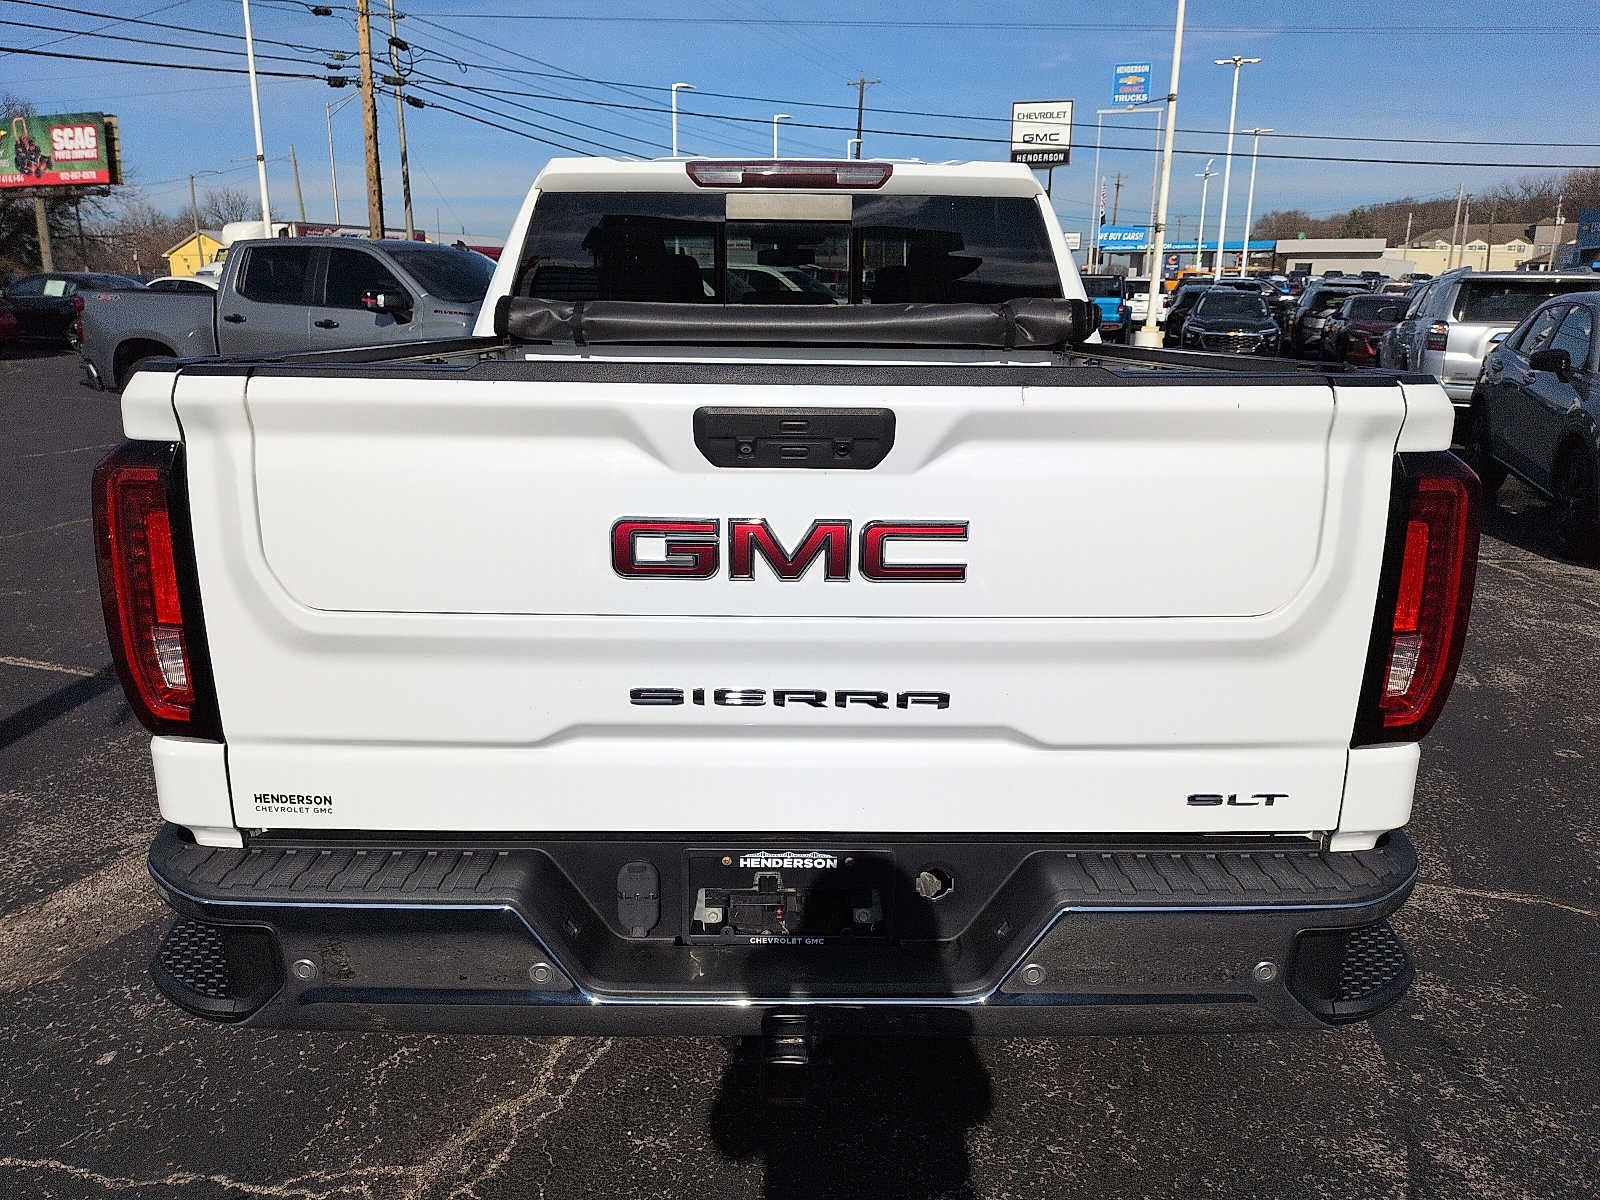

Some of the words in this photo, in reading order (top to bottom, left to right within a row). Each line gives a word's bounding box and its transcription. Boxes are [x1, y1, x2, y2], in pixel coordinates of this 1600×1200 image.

[1114, 94, 1148, 102] TRUCKS
[1017, 111, 1067, 120] CHEVROLET
[52, 126, 97, 150] SCAG
[1023, 133, 1060, 143] GMC
[1016, 153, 1065, 162] HENDERSON
[1109, 232, 1123, 240] BUY
[611, 516, 969, 583] GMC
[629, 688, 950, 709] SIERRA
[254, 793, 333, 805] HENDERSON
[1187, 794, 1289, 806] SLT
[255, 805, 309, 814] CHEVROLET
[739, 857, 838, 869] HENDERSON
[749, 937, 803, 945] CHEVROLET
